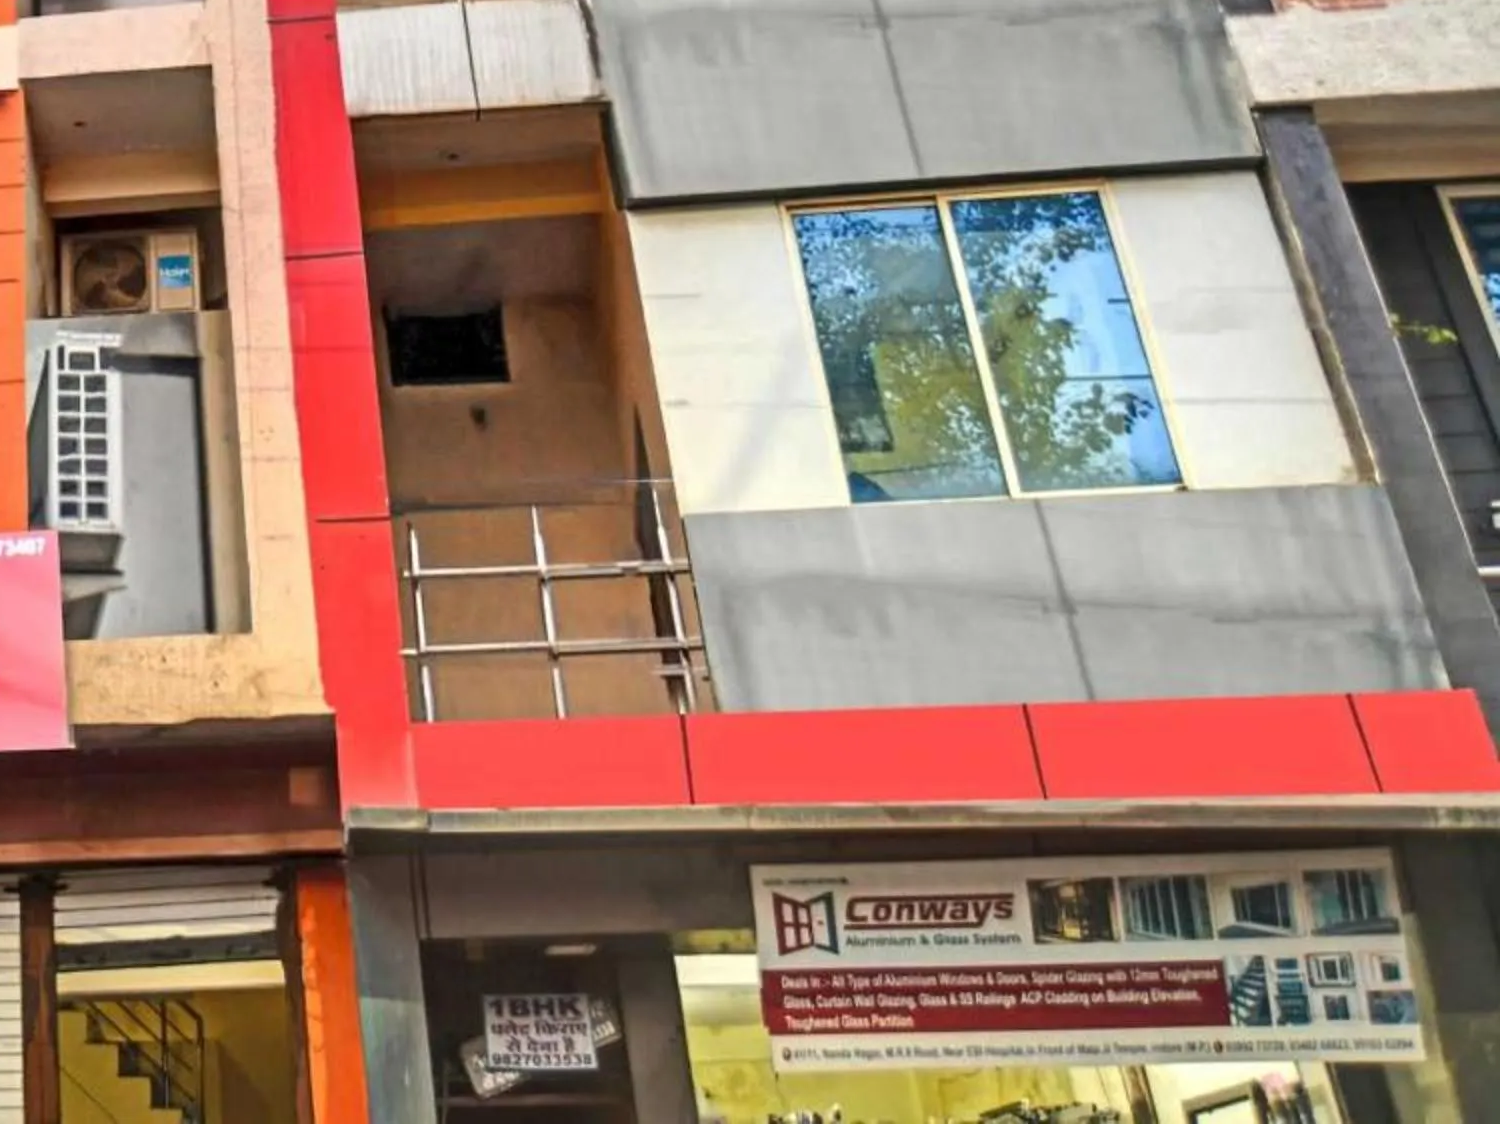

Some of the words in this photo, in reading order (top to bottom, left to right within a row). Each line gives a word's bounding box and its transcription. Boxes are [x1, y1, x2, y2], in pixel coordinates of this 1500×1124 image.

[844, 894, 1014, 930] Conways
[846, 935, 916, 947] Aluminium
[920, 935, 930, 946] &
[933, 933, 969, 946] Glass
[973, 933, 1022, 945] System
[488, 997, 583, 1017] 1BHK
